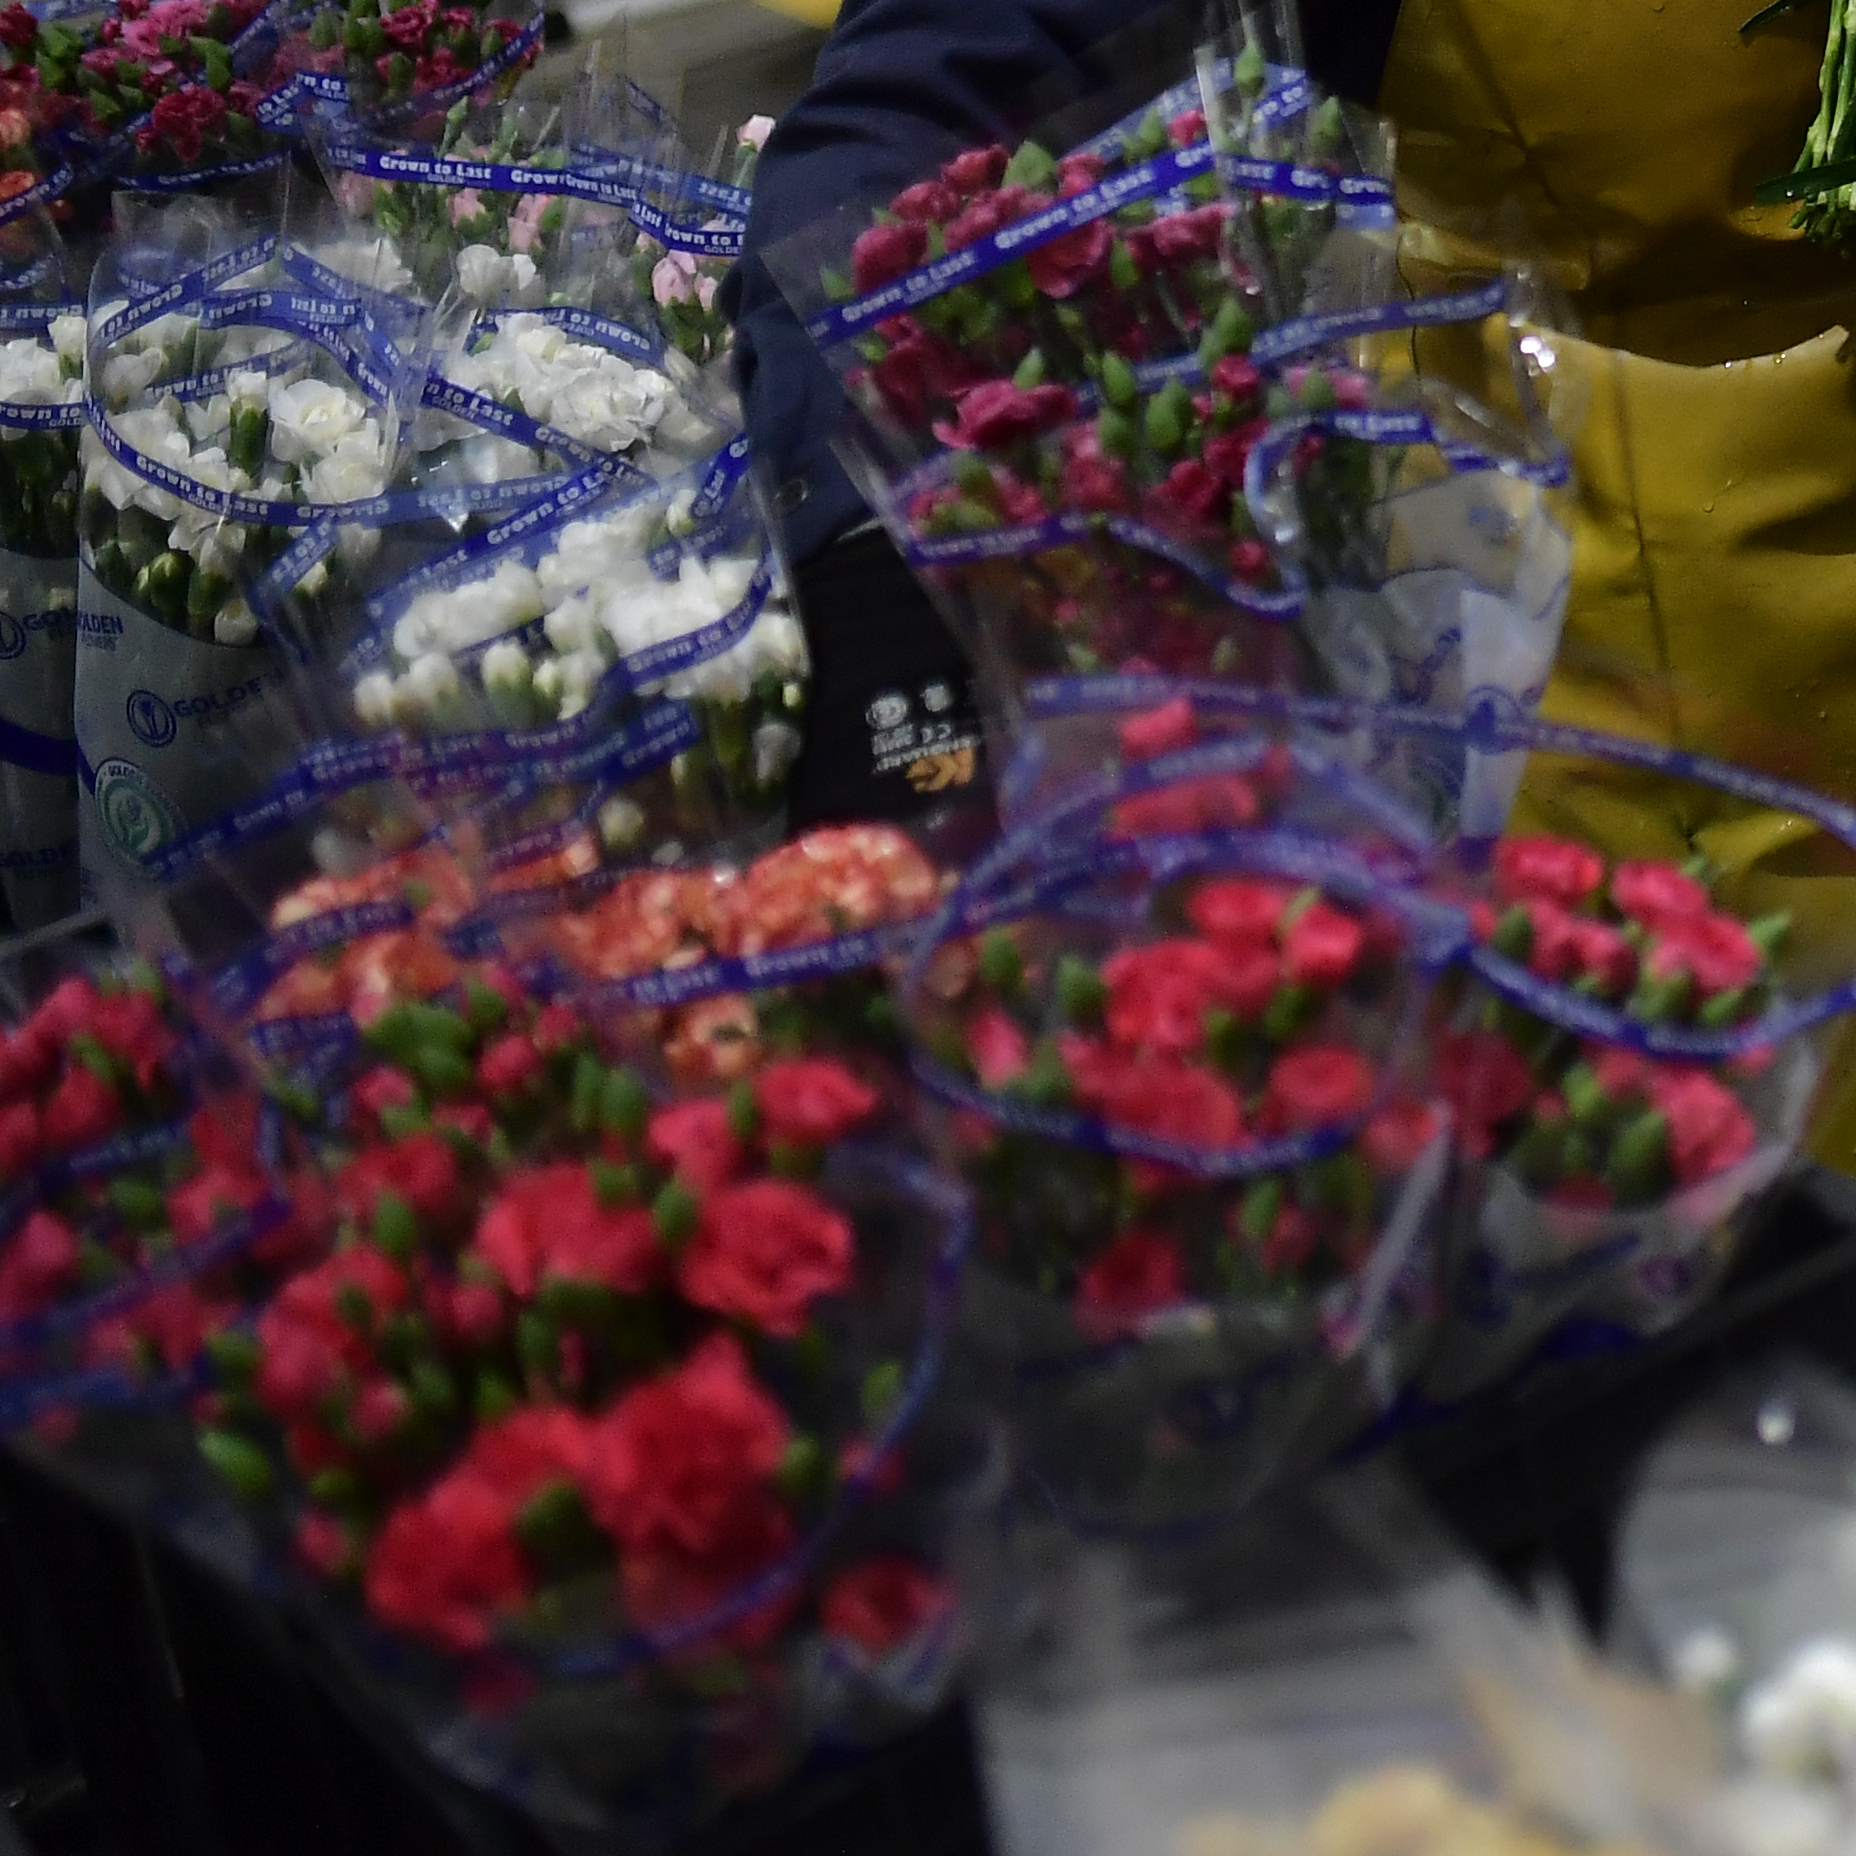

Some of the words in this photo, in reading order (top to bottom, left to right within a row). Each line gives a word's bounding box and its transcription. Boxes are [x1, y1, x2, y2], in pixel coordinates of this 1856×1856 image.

[379, 156, 430, 175] Grown
[434, 163, 451, 176] to
[456, 162, 492, 180] Last
[511, 169, 562, 187] Grow
[664, 224, 705, 245] rown
[711, 234, 731, 246] to
[704, 246, 740, 255] GOLDE
[0, 407, 52, 420] rown
[49, 418, 81, 427] GOLD
[470, 394, 514, 426] Last
[135, 455, 192, 493] Grown
[487, 502, 554, 544] Grown
[557, 486, 580, 505] to
